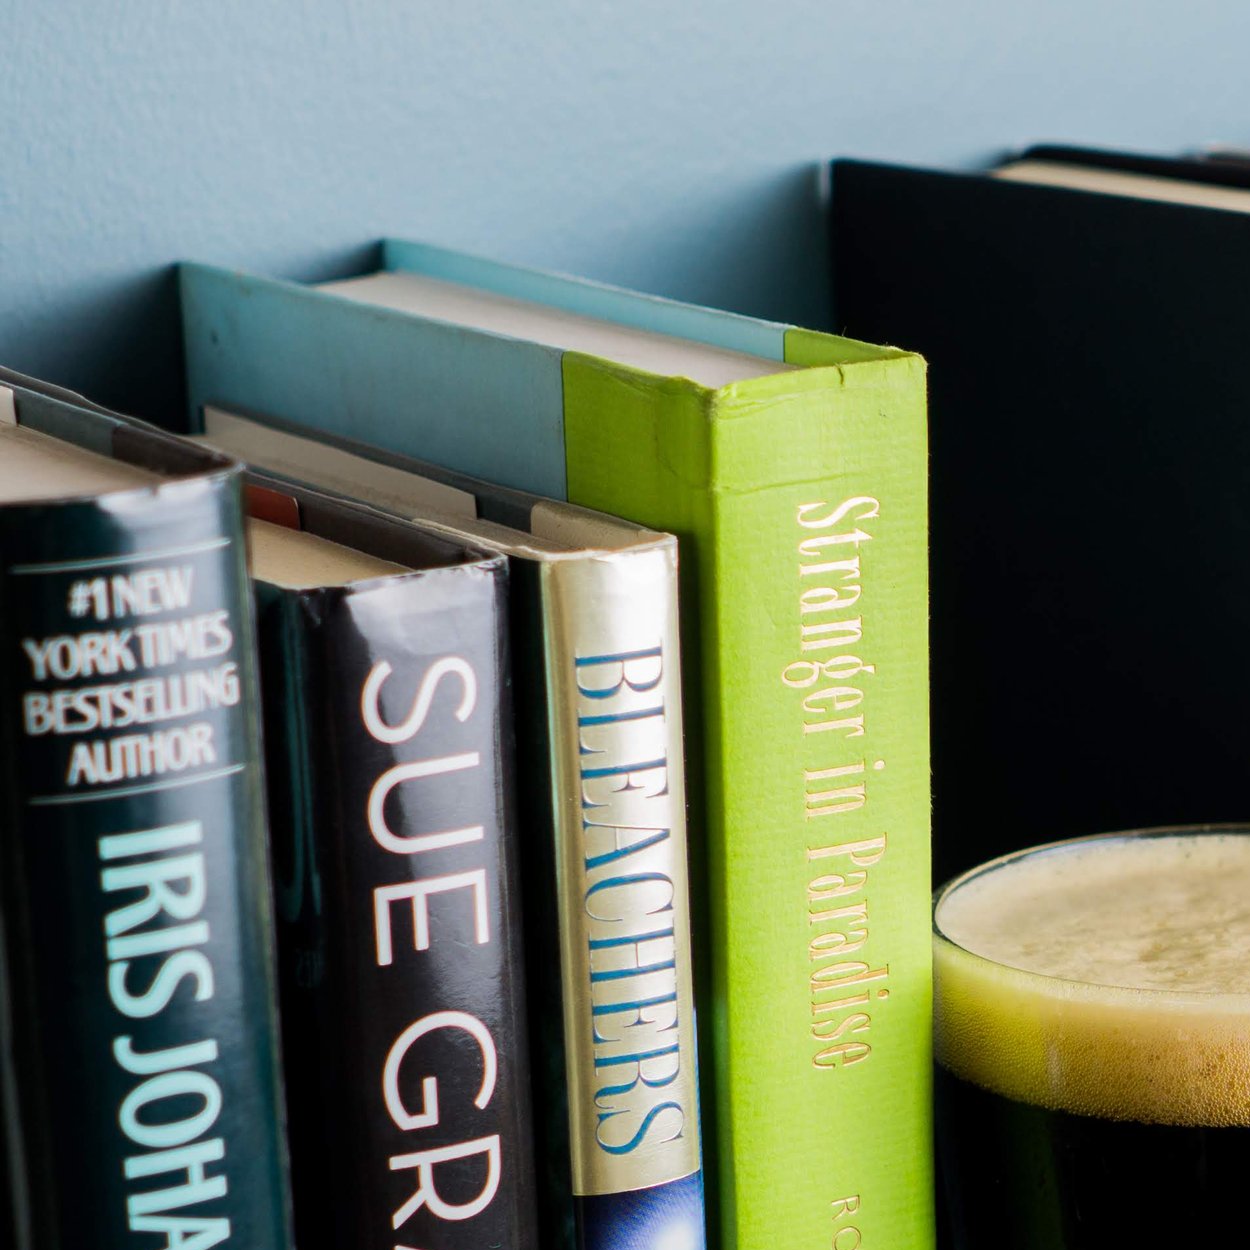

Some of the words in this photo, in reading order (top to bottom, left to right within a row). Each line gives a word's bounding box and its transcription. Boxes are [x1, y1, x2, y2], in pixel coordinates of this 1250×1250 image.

[22, 628, 137, 681] YORK
[137, 609, 233, 668] TIMES
[113, 563, 196, 617] NEW
[781, 496, 880, 736] Stranger
[24, 661, 241, 736] BESTSELLING
[66, 722, 218, 786] AUTHOR
[361, 657, 490, 966] SUE
[803, 760, 884, 822] in
[99, 820, 214, 1018] IRIS
[574, 646, 688, 1156] BLEACHERS
[805, 833, 891, 1071] Paradise
